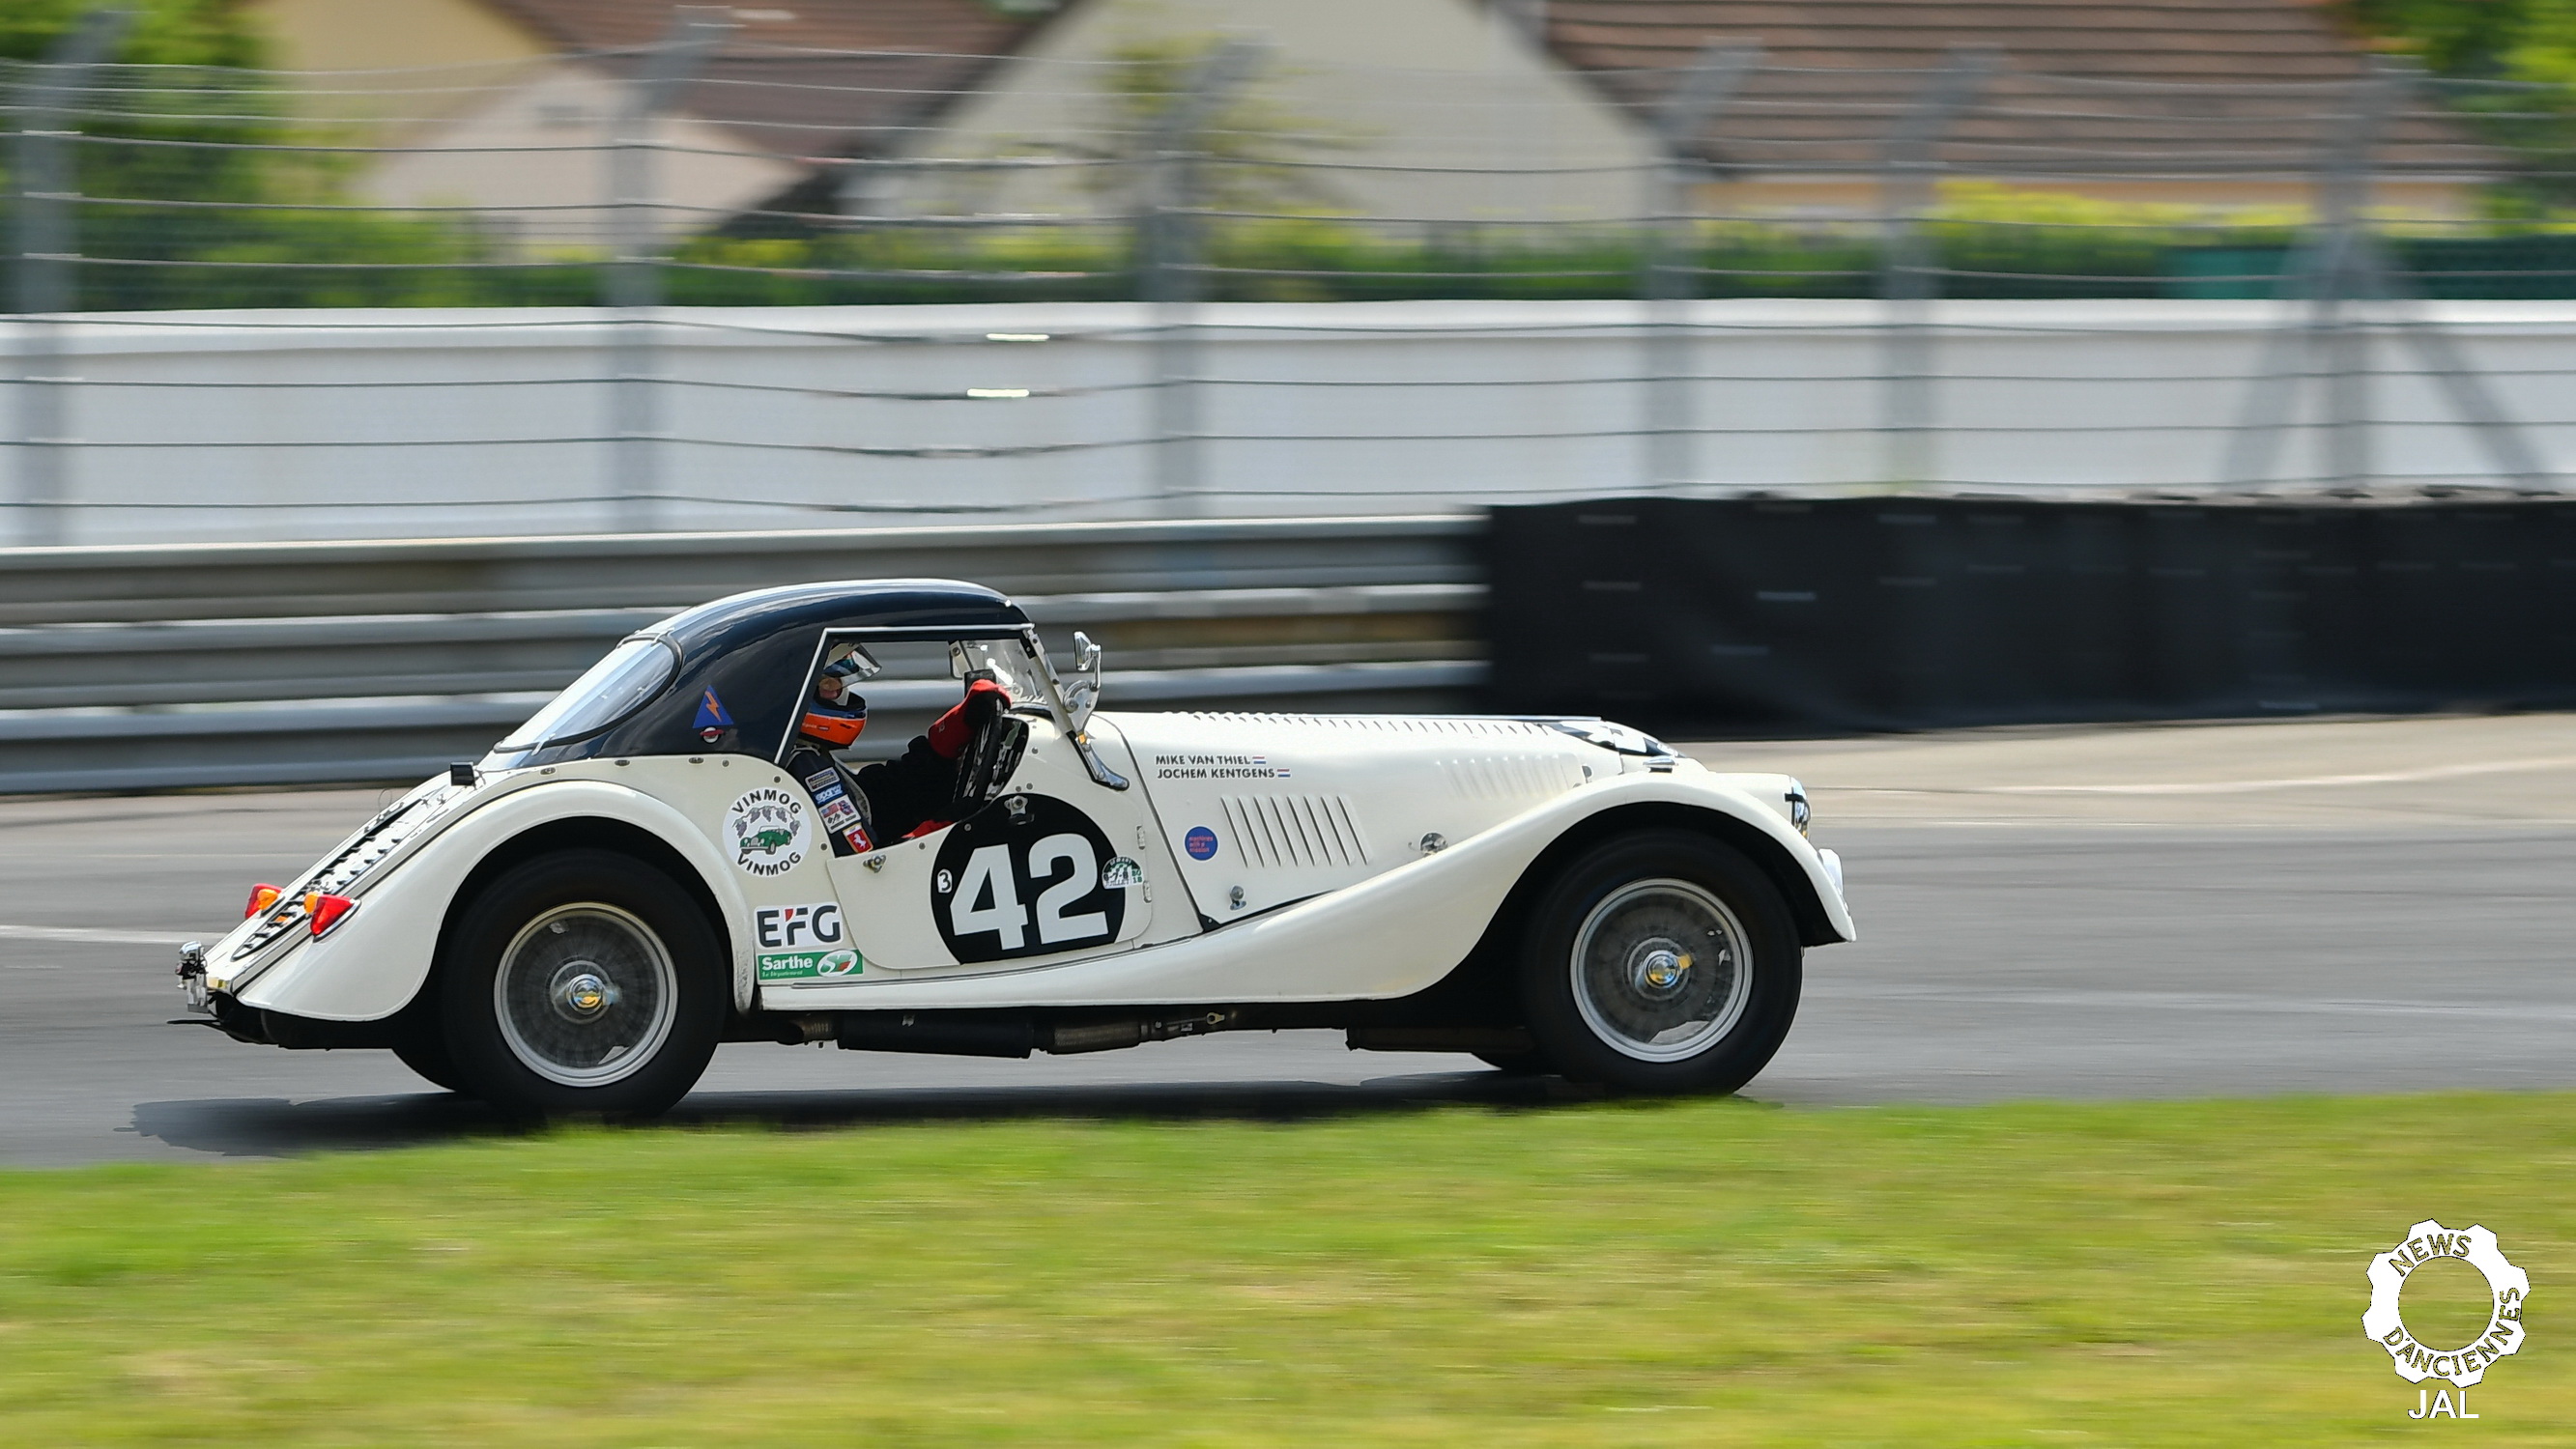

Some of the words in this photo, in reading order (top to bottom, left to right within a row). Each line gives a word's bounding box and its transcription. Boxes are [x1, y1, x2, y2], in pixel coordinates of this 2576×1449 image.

[1156, 755, 1186, 765] MIKE
[1188, 755, 1215, 765] VAN
[1216, 755, 1250, 765] THIEL
[1158, 768, 1207, 779] JOCHEM
[1211, 768, 1275, 779] KENTGENS
[731, 789, 801, 814] VINMOG
[737, 851, 801, 876] VINMOG
[939, 871, 952, 892] 3
[950, 833, 1109, 951] 42
[757, 905, 842, 947] EFG
[761, 955, 814, 971] Sarthe
